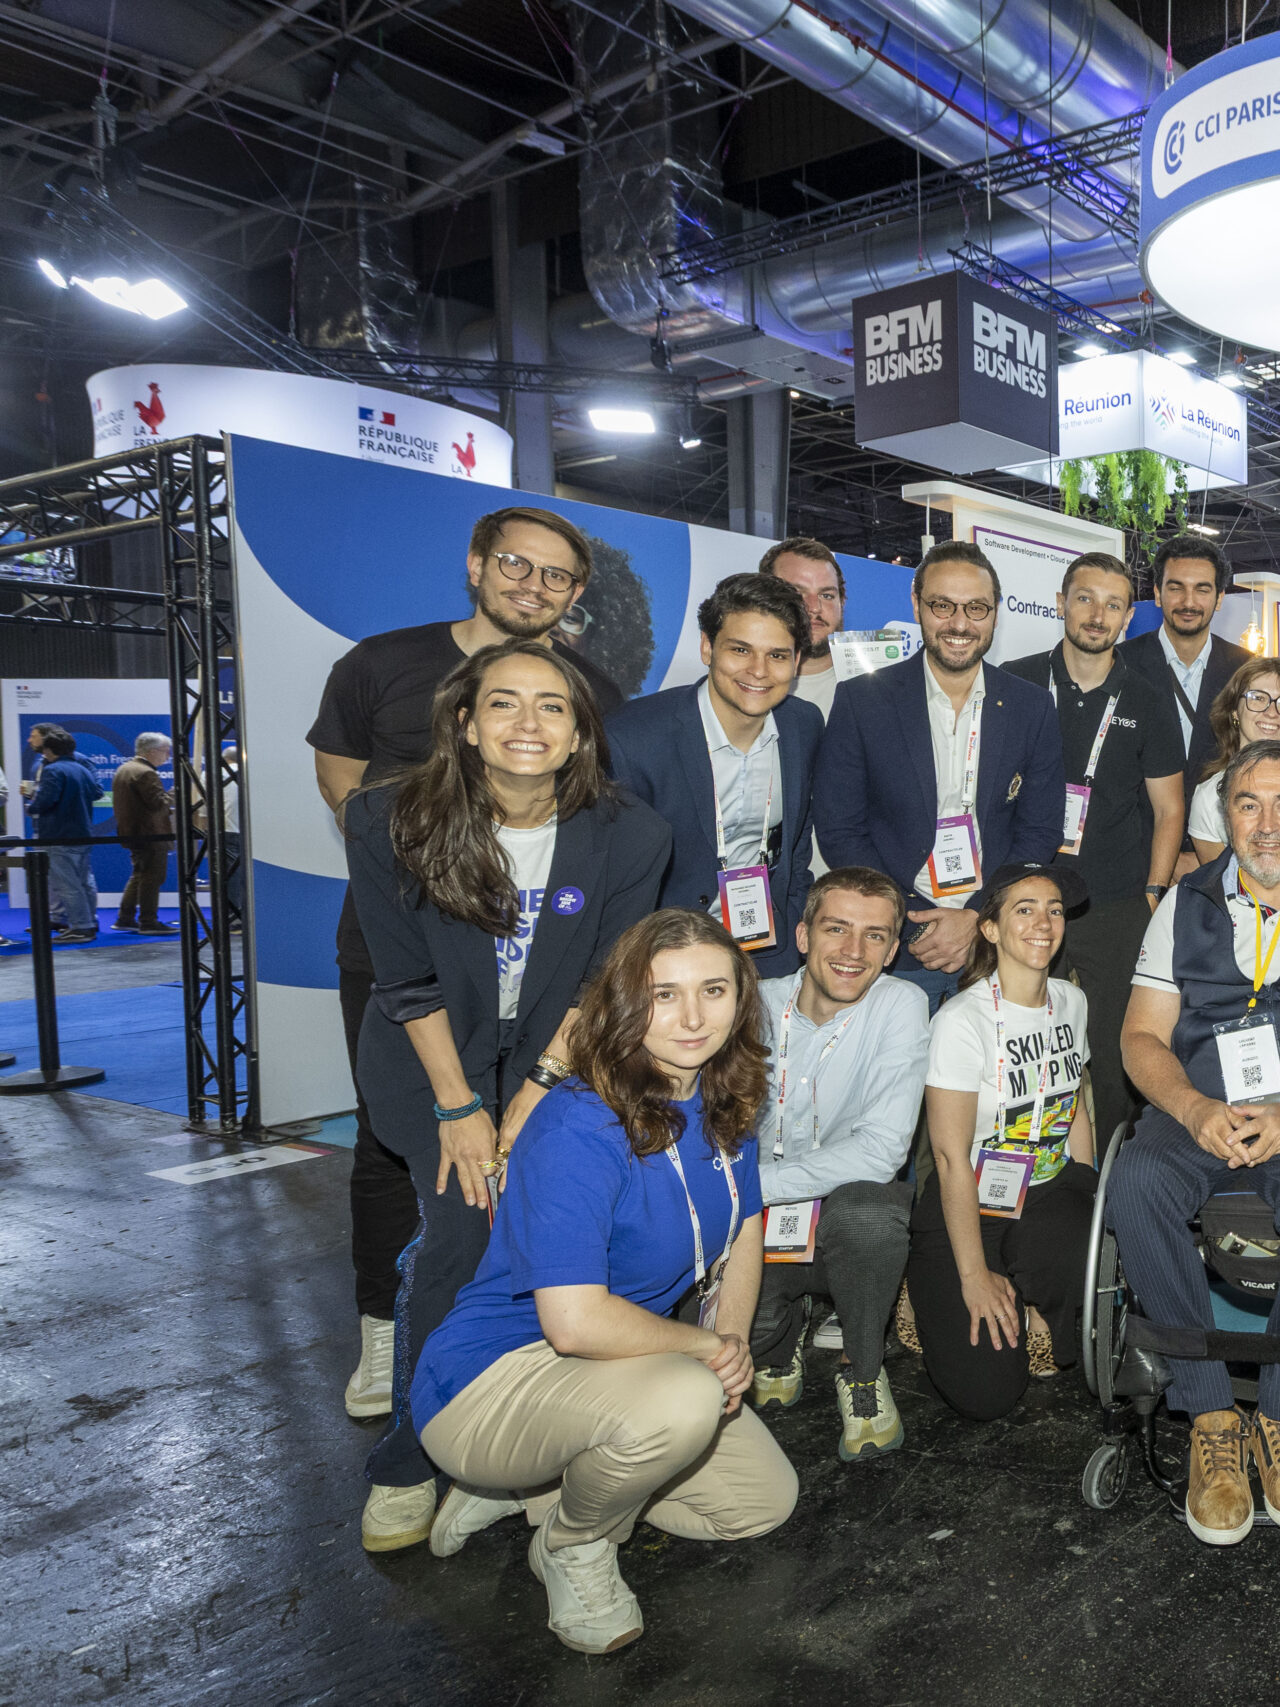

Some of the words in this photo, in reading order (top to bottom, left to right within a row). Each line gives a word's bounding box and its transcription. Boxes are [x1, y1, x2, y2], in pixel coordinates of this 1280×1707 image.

[1194, 114, 1220, 143] CCI
[865, 299, 942, 358] BFM
[973, 301, 1046, 371] BFM
[866, 343, 943, 386] BUSINESS
[973, 344, 1047, 399] BUSINESS
[1064, 392, 1132, 416] Réunion
[134, 426, 146, 437] LA
[1181, 404, 1195, 421] La
[1197, 409, 1241, 442] Réunion
[358, 425, 439, 453] RÉPUBLIQUE
[359, 439, 435, 464] FRANÇAISE
[451, 465, 463, 475] LA
[984, 538, 1010, 551] Software
[1011, 545, 1046, 560] Development
[1050, 554, 1066, 564] Cloud
[1111, 715, 1137, 729] EYOS
[1008, 1052, 1082, 1098] MAPING
[1240, 1280, 1276, 1290] VICAIR
